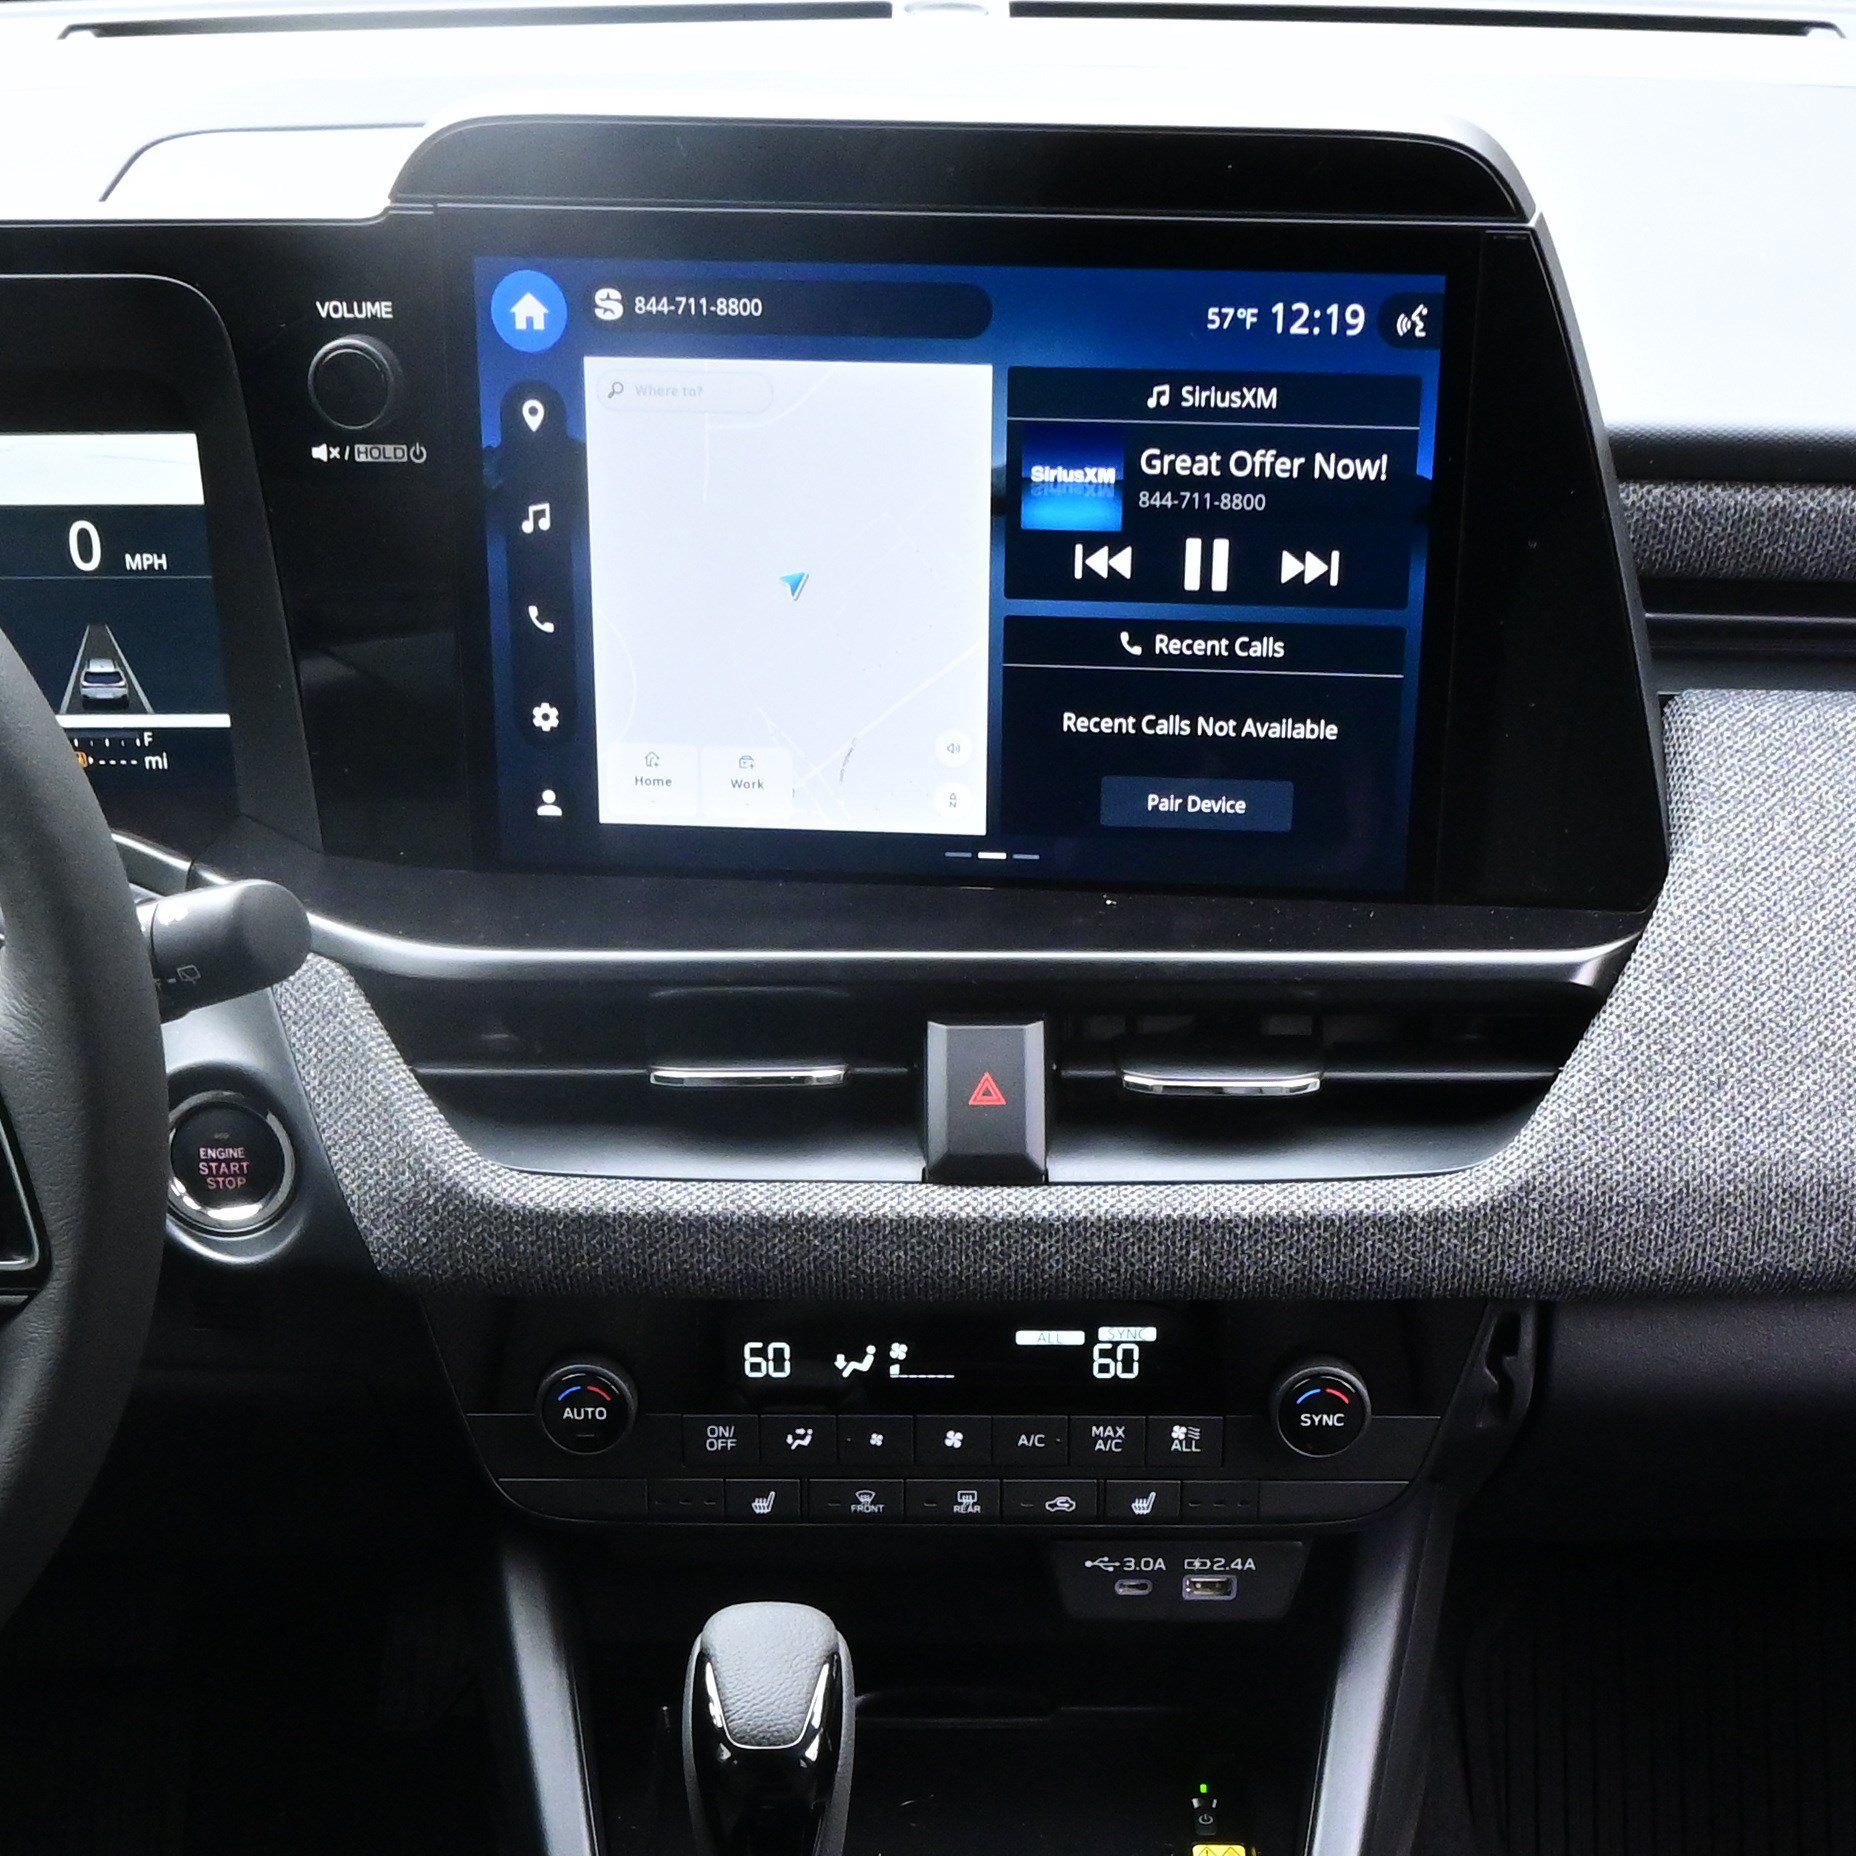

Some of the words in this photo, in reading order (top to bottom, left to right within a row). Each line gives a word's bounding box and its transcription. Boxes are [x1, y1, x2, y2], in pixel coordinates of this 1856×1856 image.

[316, 301, 393, 318] VOLUME
[635, 296, 762, 316] 844-711-8800
[1207, 307, 1258, 329] 57°F
[1272, 302, 1365, 336] 12:19
[634, 384, 678, 396] Where
[1181, 386, 1277, 409] SiriusXM
[356, 447, 405, 460] HOLD
[1141, 448, 1221, 476] Great
[1229, 449, 1305, 478] Offer
[1314, 452, 1387, 481] Now!
[1029, 465, 1117, 484] SiriusXM
[1139, 491, 1265, 511] 844-711-8800
[69, 520, 101, 571] 0
[125, 553, 167, 570] MPH
[1156, 634, 1229, 656] Recent
[1235, 636, 1284, 657] Calls
[1063, 712, 1136, 733] Recent
[1142, 715, 1191, 735] Calls
[1198, 716, 1237, 737] Not
[1241, 718, 1338, 740] Available
[144, 732, 152, 746] F
[145, 752, 168, 769] mi
[635, 776, 671, 786] Home
[731, 779, 763, 789] Work
[1148, 794, 1183, 811] Pair
[1187, 795, 1246, 814] Device
[199, 1147, 245, 1159] ENGINE
[198, 1161, 250, 1175] START
[206, 1177, 246, 1190] STOP
[744, 1342, 790, 1378] 60
[1093, 1343, 1139, 1379] 60
[563, 1407, 606, 1420] AUTO
[1301, 1414, 1344, 1426] SYNC
[707, 1426, 734, 1437] ON/
[1092, 1426, 1125, 1438] MAX
[706, 1439, 737, 1451] OFF
[1018, 1434, 1045, 1447] A/C
[1095, 1439, 1122, 1452] A/C
[1170, 1441, 1202, 1452] ALL
[850, 1505, 885, 1514] FRONT
[952, 1505, 982, 1514] REAR
[1123, 1558, 1166, 1570] 3.0A
[1213, 1558, 1255, 1570] 2.4A
